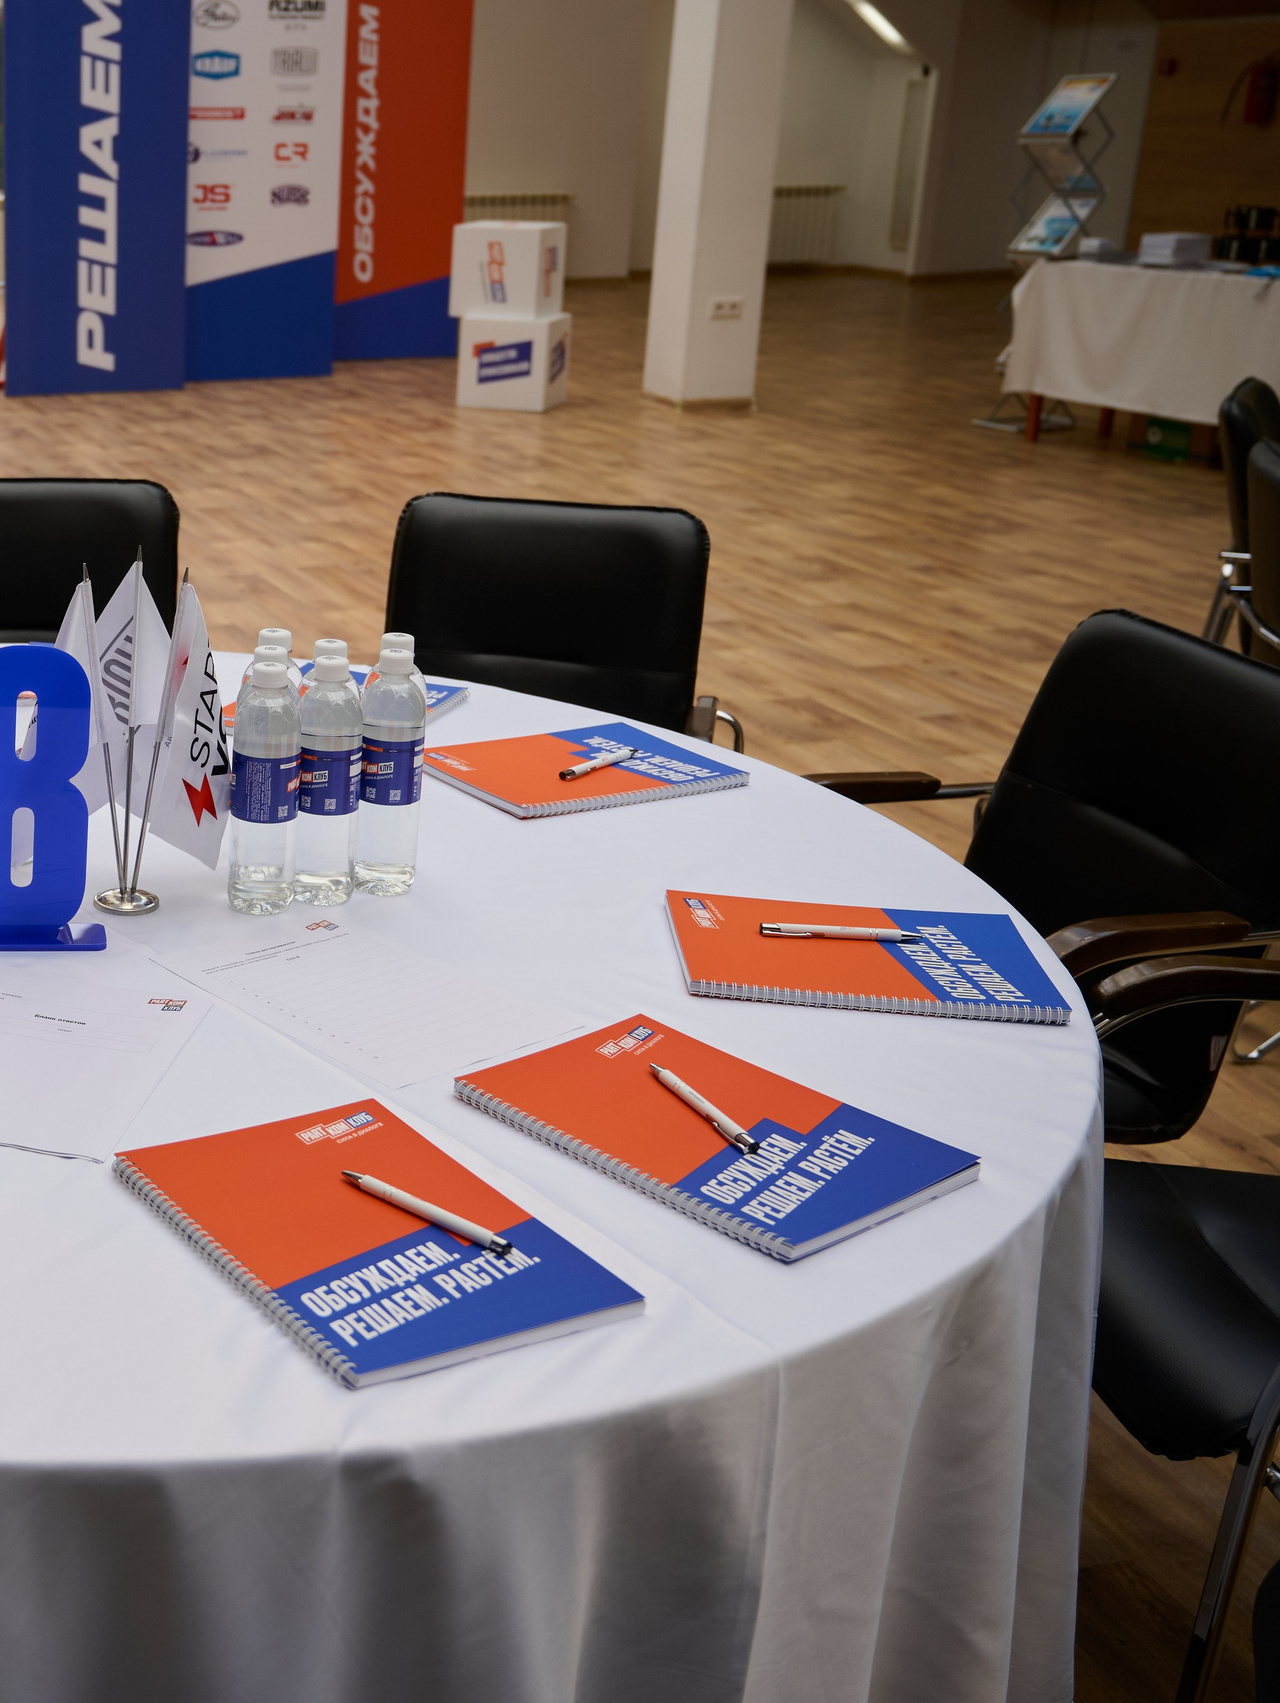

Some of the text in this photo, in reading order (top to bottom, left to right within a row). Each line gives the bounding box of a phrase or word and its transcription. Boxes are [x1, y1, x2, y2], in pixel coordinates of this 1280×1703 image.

[353, 3, 380, 283] ОБСУЖДАЕМ
[77, 0, 122, 372] РЕШАЕМ
[957, 963, 1032, 1002] РЕШАЕМ.
[346, 1111, 373, 1128] КЛУБ
[699, 1133, 808, 1205] ОБСУЖДАЕМ.
[740, 1129, 876, 1225] РЕШАЕМ. РАСТЁМ.
[300, 1241, 461, 1318] ОБСУЖДАЕМ.
[329, 1283, 450, 1347] РЕШАЕМ.
